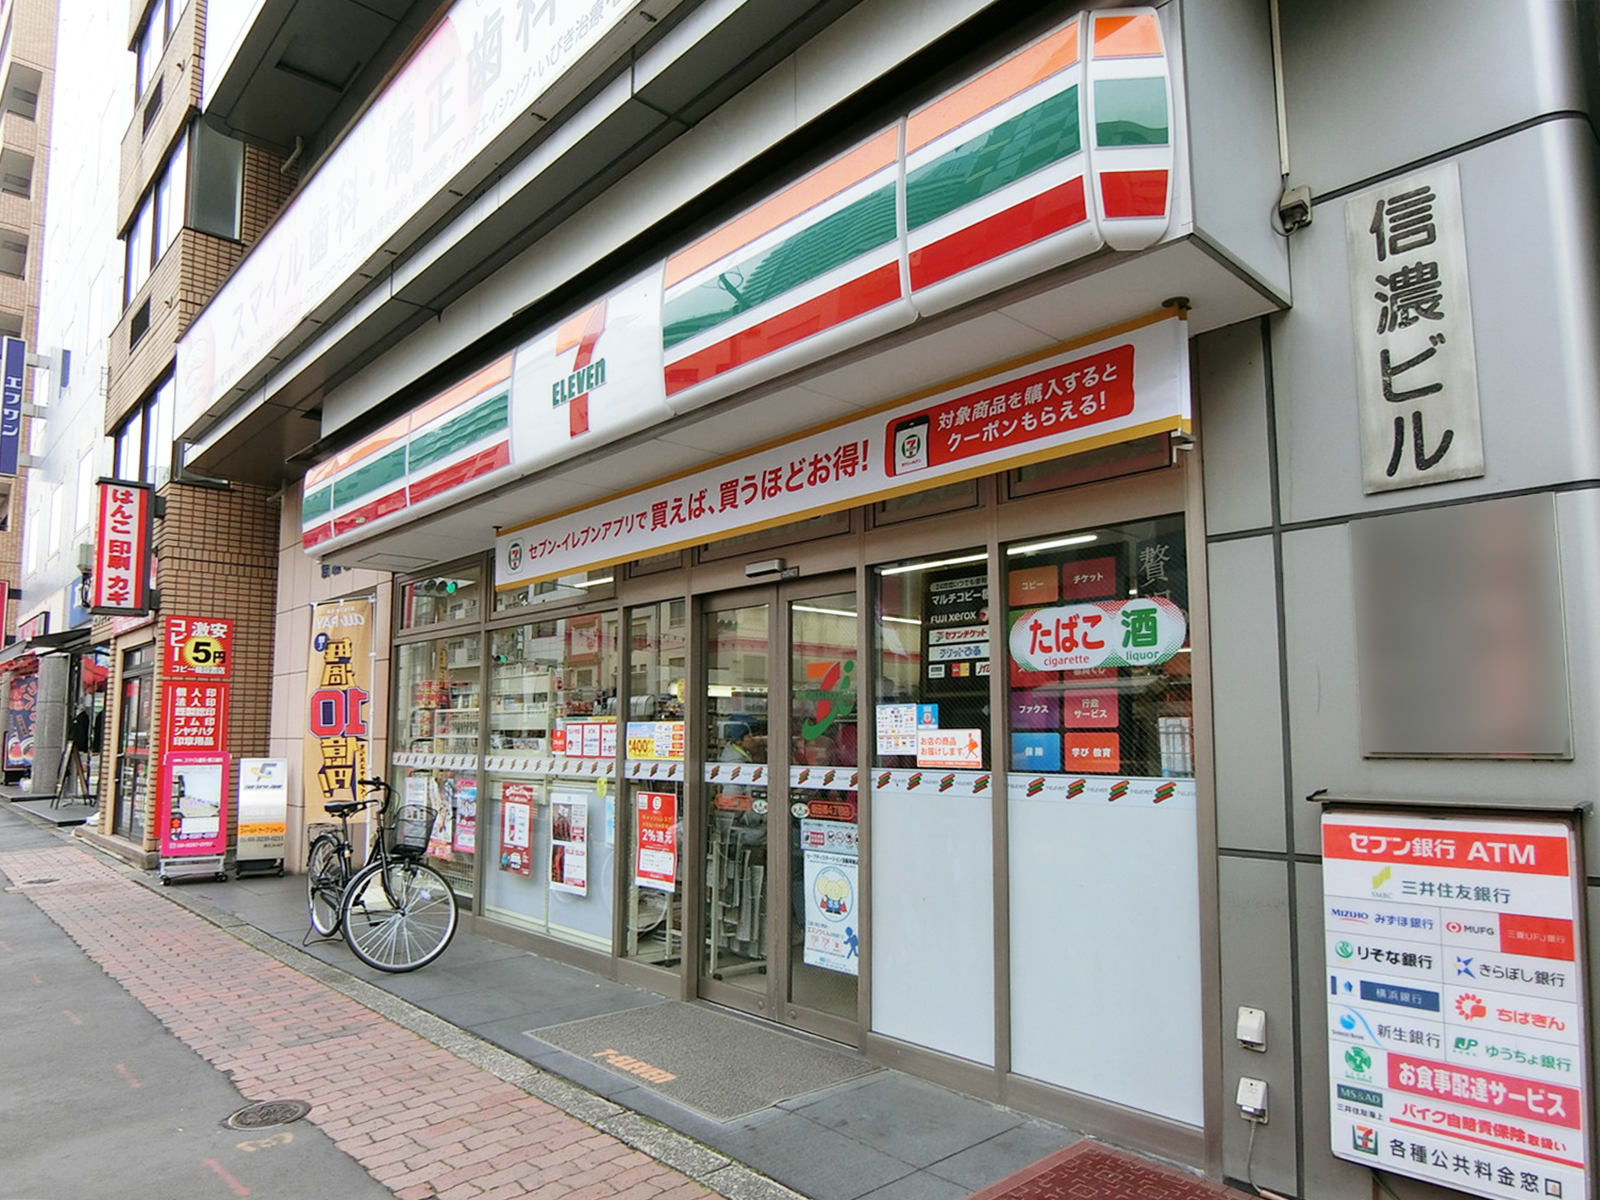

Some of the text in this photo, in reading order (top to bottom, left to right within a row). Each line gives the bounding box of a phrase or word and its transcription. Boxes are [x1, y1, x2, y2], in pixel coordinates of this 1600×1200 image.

[1369, 185, 1454, 477] 信濃ビル
[937, 363, 1118, 431] 対象商品を購入すると
[947, 391, 1106, 453] クーポンもらえる!
[106, 489, 134, 606] はんこ 印刷 カギ
[1021, 581, 1045, 591] コピー
[1073, 572, 1104, 584] チケット
[191, 621, 228, 639] 激安
[1029, 613, 1105, 655] たばこ
[1120, 607, 1158, 649] 酒
[170, 619, 187, 662] コピー
[192, 641, 226, 664] 5円
[1043, 654, 1090, 667] cigarette
[1126, 650, 1160, 662] liquor
[1018, 704, 1049, 714] ファクス
[1073, 709, 1108, 719] サービス
[920, 736, 957, 747] お店の商品
[1348, 832, 1536, 865] セブン銀行 ATM
[1402, 880, 1511, 905] 三井住友銀行
[1331, 908, 1434, 931] MIZUHO みずほ銀行
[1463, 924, 1495, 936] MUFG
[1507, 929, 1566, 944] 三菱UFJ銀行
[1357, 945, 1433, 970] りそな銀行
[1479, 963, 1566, 988] きらぼし銀行
[1376, 987, 1423, 1005] 横浜銀行
[1377, 1023, 1442, 1049] 新生銀行
[1485, 1045, 1572, 1072] ゆうちょ銀行
[1340, 1087, 1381, 1104] MS&AD
[1399, 1062, 1567, 1118] お食事配達サービス
[1336, 1103, 1384, 1121] 三井住友海上
[1389, 1138, 1563, 1199] 各種公共料金窓口
